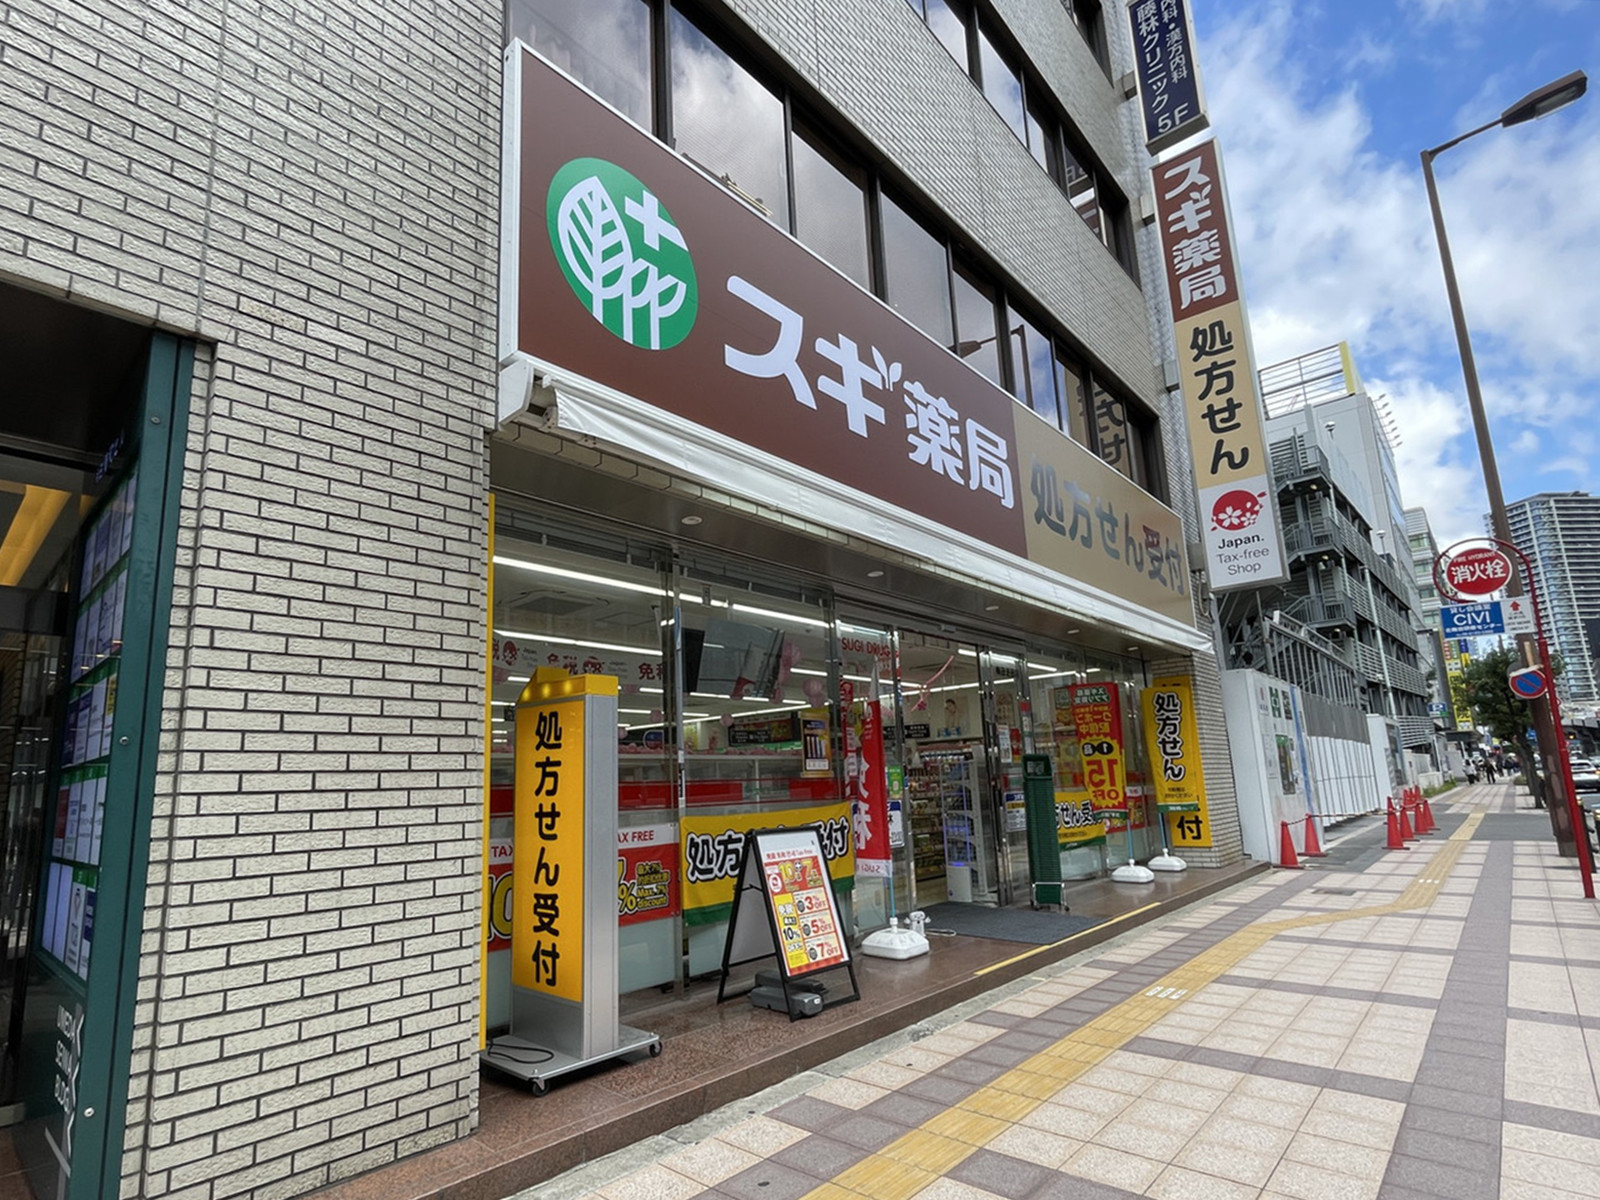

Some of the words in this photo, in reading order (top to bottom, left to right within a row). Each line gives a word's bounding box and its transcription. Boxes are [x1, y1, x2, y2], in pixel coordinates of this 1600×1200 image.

[1158, 102, 1189, 133] 5F
[1163, 156, 1227, 310] スギ薬局
[724, 275, 1014, 509] スギ薬局
[1189, 319, 1250, 475] 処方せん
[1030, 460, 1185, 596] 処方せん受付
[1217, 534, 1265, 550] Japan.
[1216, 547, 1270, 564] Tax-free
[1227, 562, 1262, 576] Shop
[1450, 558, 1506, 585] 消火栓
[1453, 610, 1491, 626] CIVI
[841, 637, 864, 652] SUGI
[1154, 692, 1185, 782] 処方せん
[532, 710, 563, 988] 処方せん受付
[631, 830, 654, 842] FREE
